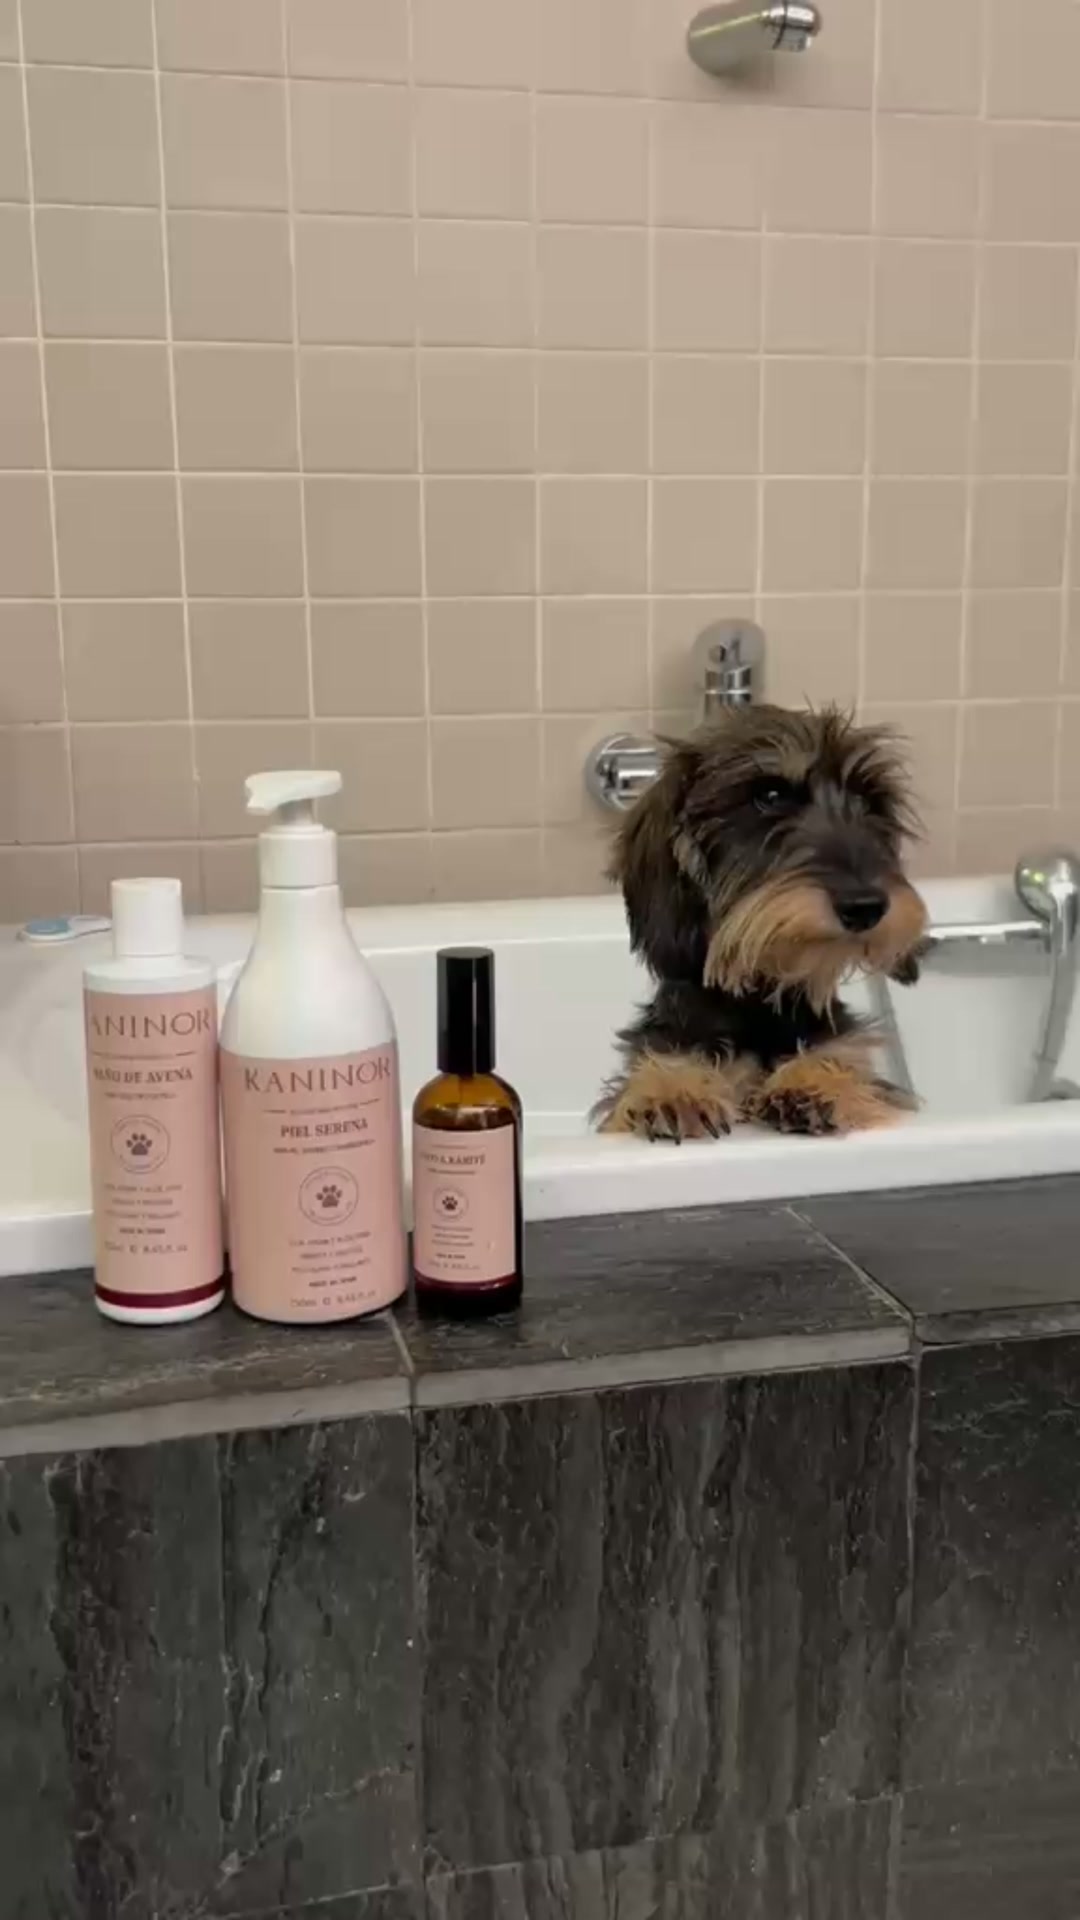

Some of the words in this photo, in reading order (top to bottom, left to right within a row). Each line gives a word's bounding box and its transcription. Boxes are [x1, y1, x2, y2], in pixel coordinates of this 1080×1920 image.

[91, 1008, 211, 1039] ANINOR
[145, 1068, 193, 1083] AVENA
[244, 1056, 391, 1094] KANINOR
[280, 1124, 312, 1138] PIEL
[315, 1118, 369, 1137] SERENA
